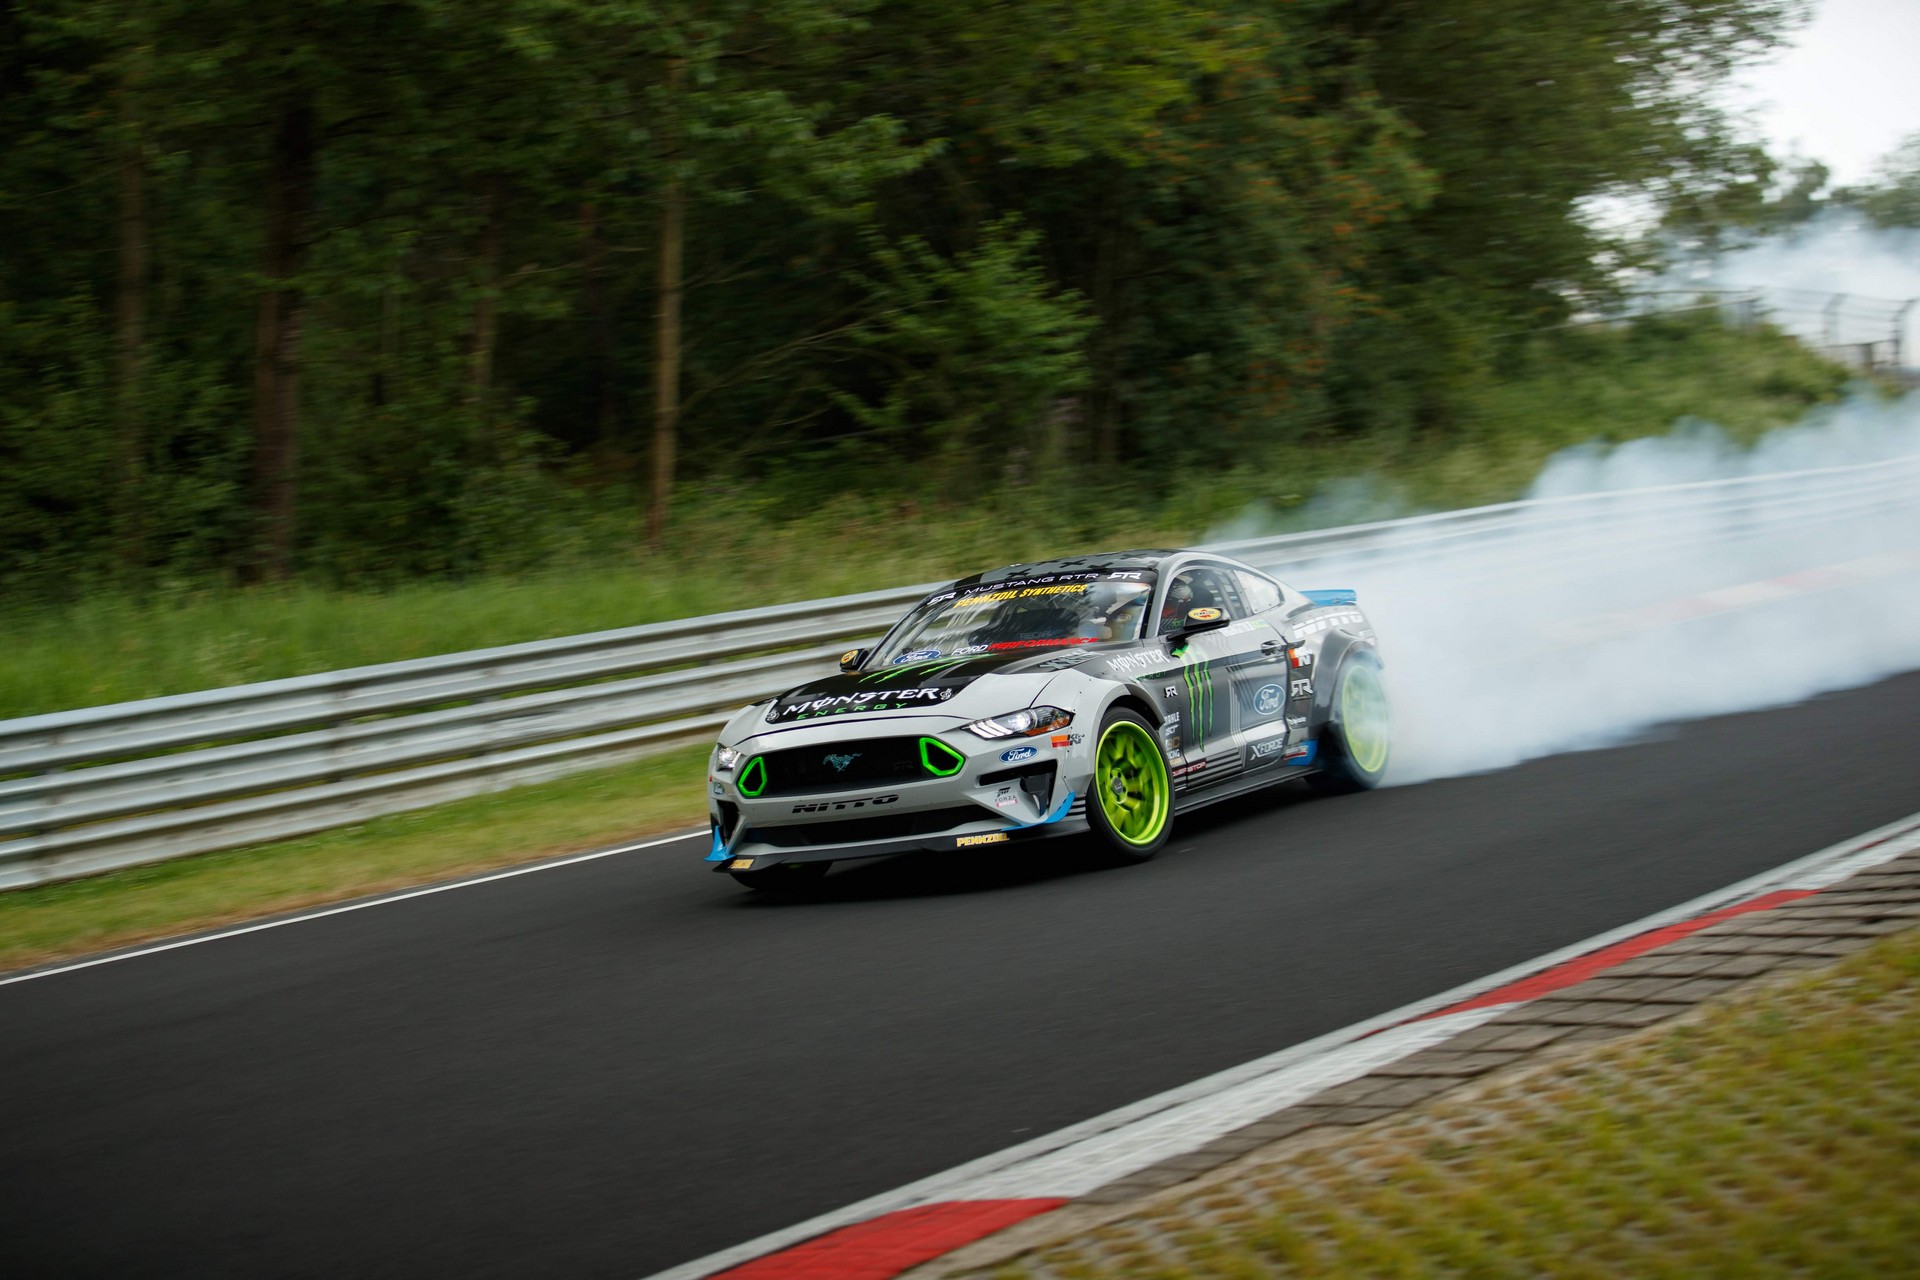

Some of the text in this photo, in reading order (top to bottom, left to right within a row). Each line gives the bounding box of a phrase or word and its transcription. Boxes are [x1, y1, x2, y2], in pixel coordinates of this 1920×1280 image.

[964, 575, 1055, 595] MUSTANG
[1058, 573, 1099, 581] RTR
[953, 583, 1088, 609] PENNZOIL SYNTHETICS
[1292, 610, 1364, 640] NITTO
[951, 636, 1100, 656] FORD PERFORMANCE
[1105, 649, 1170, 673] MONSTER
[1291, 678, 1314, 697] RTR
[782, 687, 940, 717] MONSTER
[796, 702, 908, 721] ENERGY
[792, 794, 900, 814] NITTO
[994, 795, 1017, 803] FORZA
[956, 832, 1010, 848] PENNZOIL
